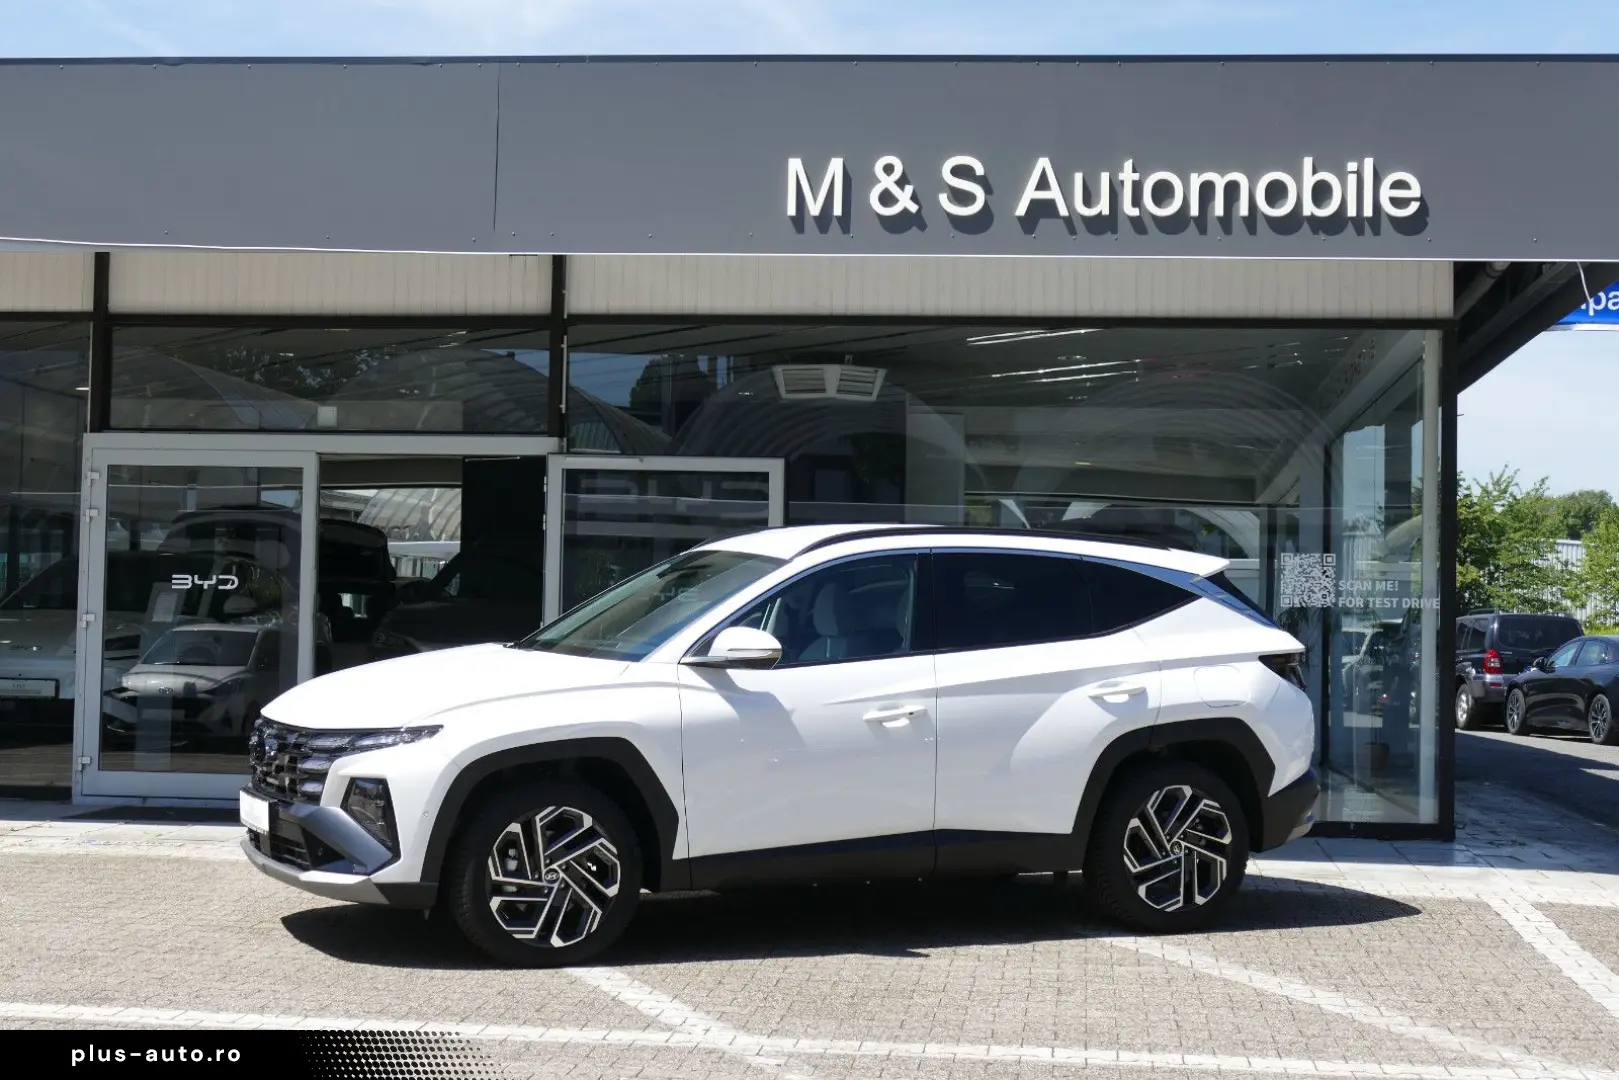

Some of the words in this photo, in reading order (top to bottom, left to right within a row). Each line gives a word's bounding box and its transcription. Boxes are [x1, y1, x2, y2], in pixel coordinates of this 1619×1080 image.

[786, 157, 844, 217] M
[868, 154, 919, 218] &
[938, 154, 986, 218] S
[1014, 156, 1421, 218] Automobile
[172, 574, 238, 589] BYD
[1338, 580, 1372, 591] SCAN
[1375, 580, 1399, 591] ME!
[1338, 597, 1364, 608] FOR
[1368, 597, 1398, 608] TEST
[1402, 598, 1440, 609] DRIVE
